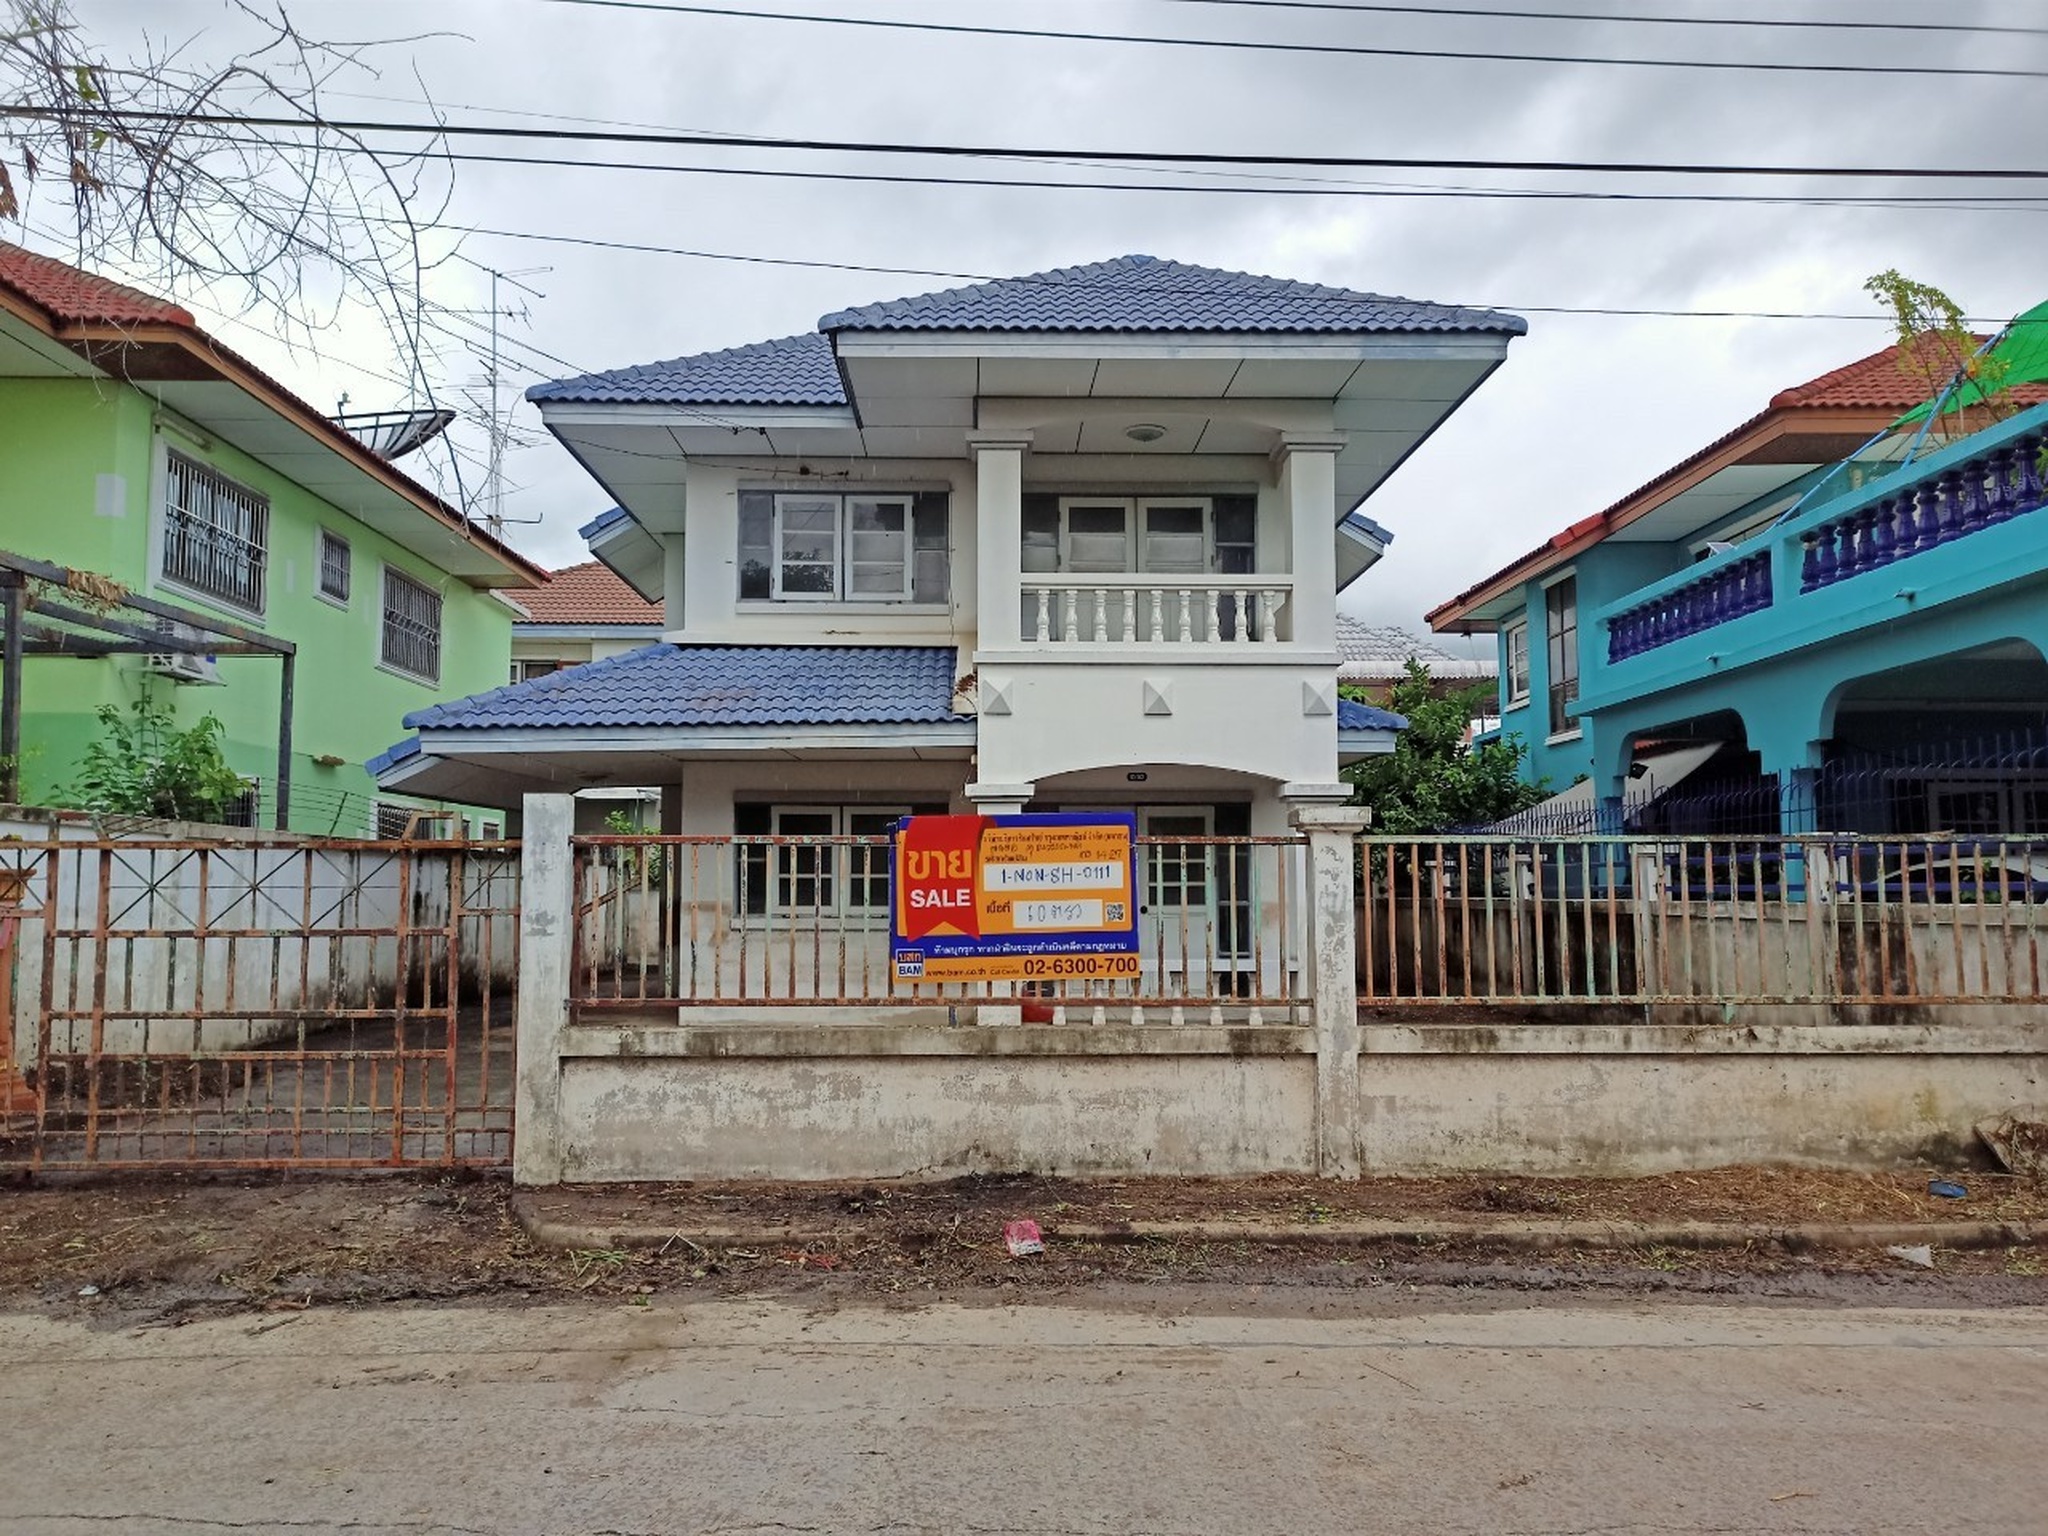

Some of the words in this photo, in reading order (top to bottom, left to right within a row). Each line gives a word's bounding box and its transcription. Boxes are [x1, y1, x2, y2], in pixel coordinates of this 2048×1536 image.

[906, 849, 972, 879] ขาย
[910, 889, 971, 908] SALE
[898, 965, 922, 975] BAM
[1024, 957, 1138, 975] 02-6300-700
